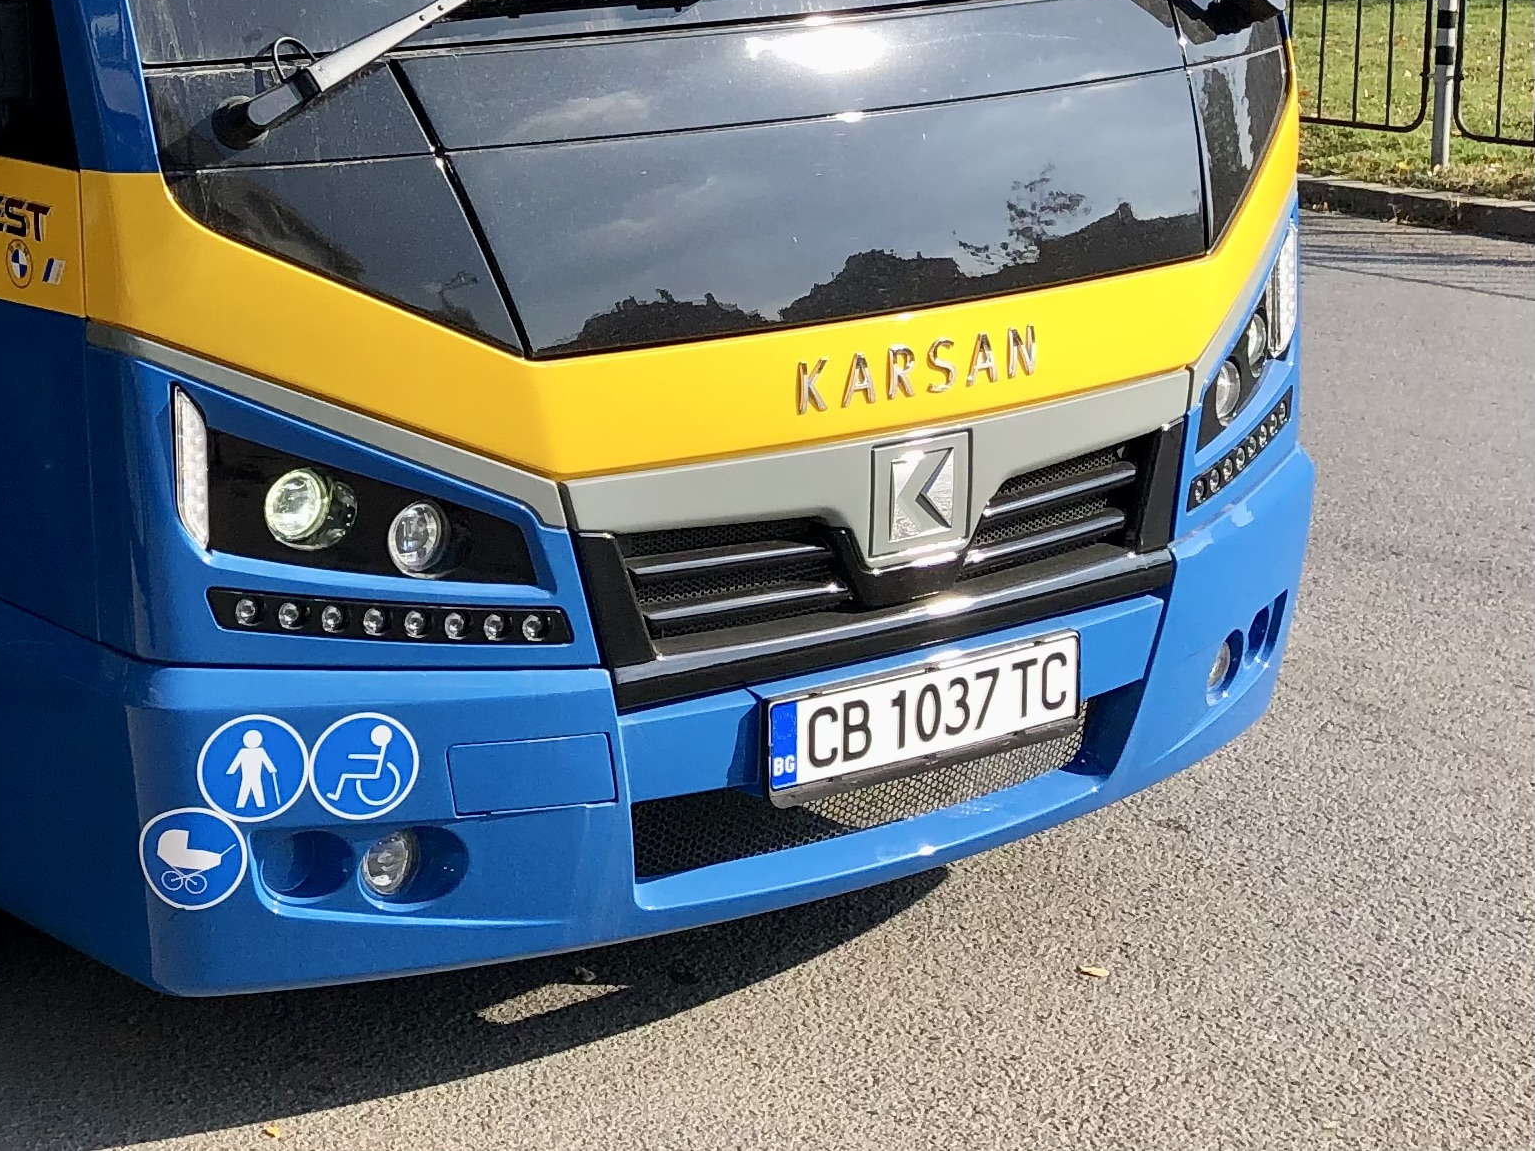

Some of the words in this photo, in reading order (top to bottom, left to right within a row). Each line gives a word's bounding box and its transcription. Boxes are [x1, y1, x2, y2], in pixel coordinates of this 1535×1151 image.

[797, 324, 1036, 415] KARSAN
[808, 699, 872, 768] CB
[891, 668, 1000, 749] 1037
[1012, 652, 1067, 718] TC
[773, 756, 796, 777] BG
